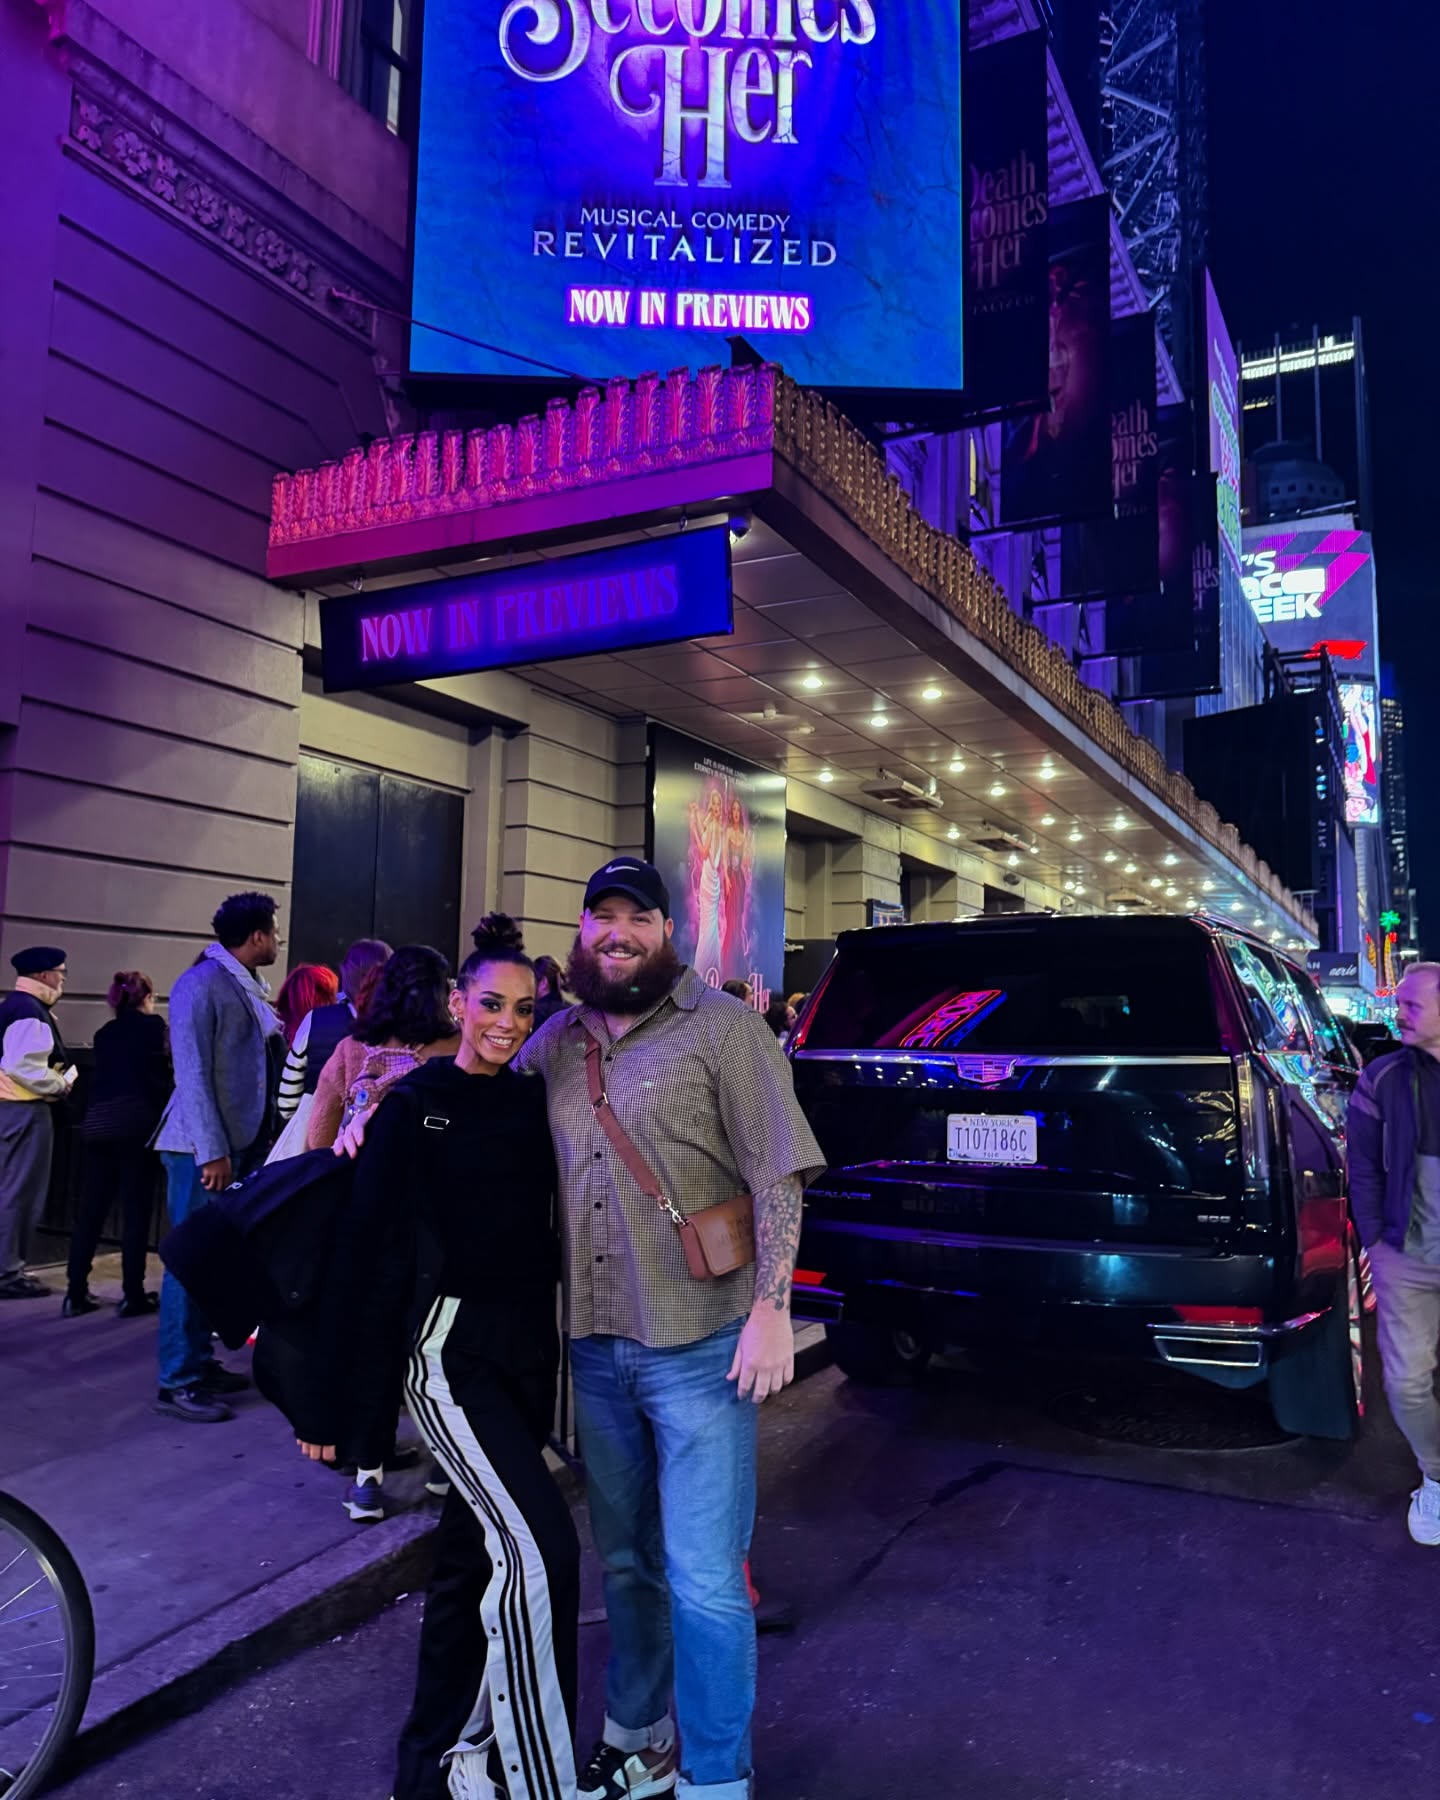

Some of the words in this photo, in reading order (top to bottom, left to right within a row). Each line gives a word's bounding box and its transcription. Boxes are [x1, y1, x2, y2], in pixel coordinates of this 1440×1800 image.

[609, 44, 813, 189] Her
[580, 207, 683, 229] MUSICAL
[691, 211, 791, 232] COMEDY
[532, 230, 837, 267] REVITALIZED
[568, 288, 630, 323] NOW
[640, 291, 666, 325] IN
[676, 292, 809, 330] PREVIEWS
[361, 607, 433, 662] NOW
[448, 599, 479, 649] IN
[496, 564, 679, 642] PREVIEWS
[955, 1127, 1028, 1152] T107186C
[969, 1118, 988, 1127] NEW
[990, 1118, 1014, 1128] YORK
